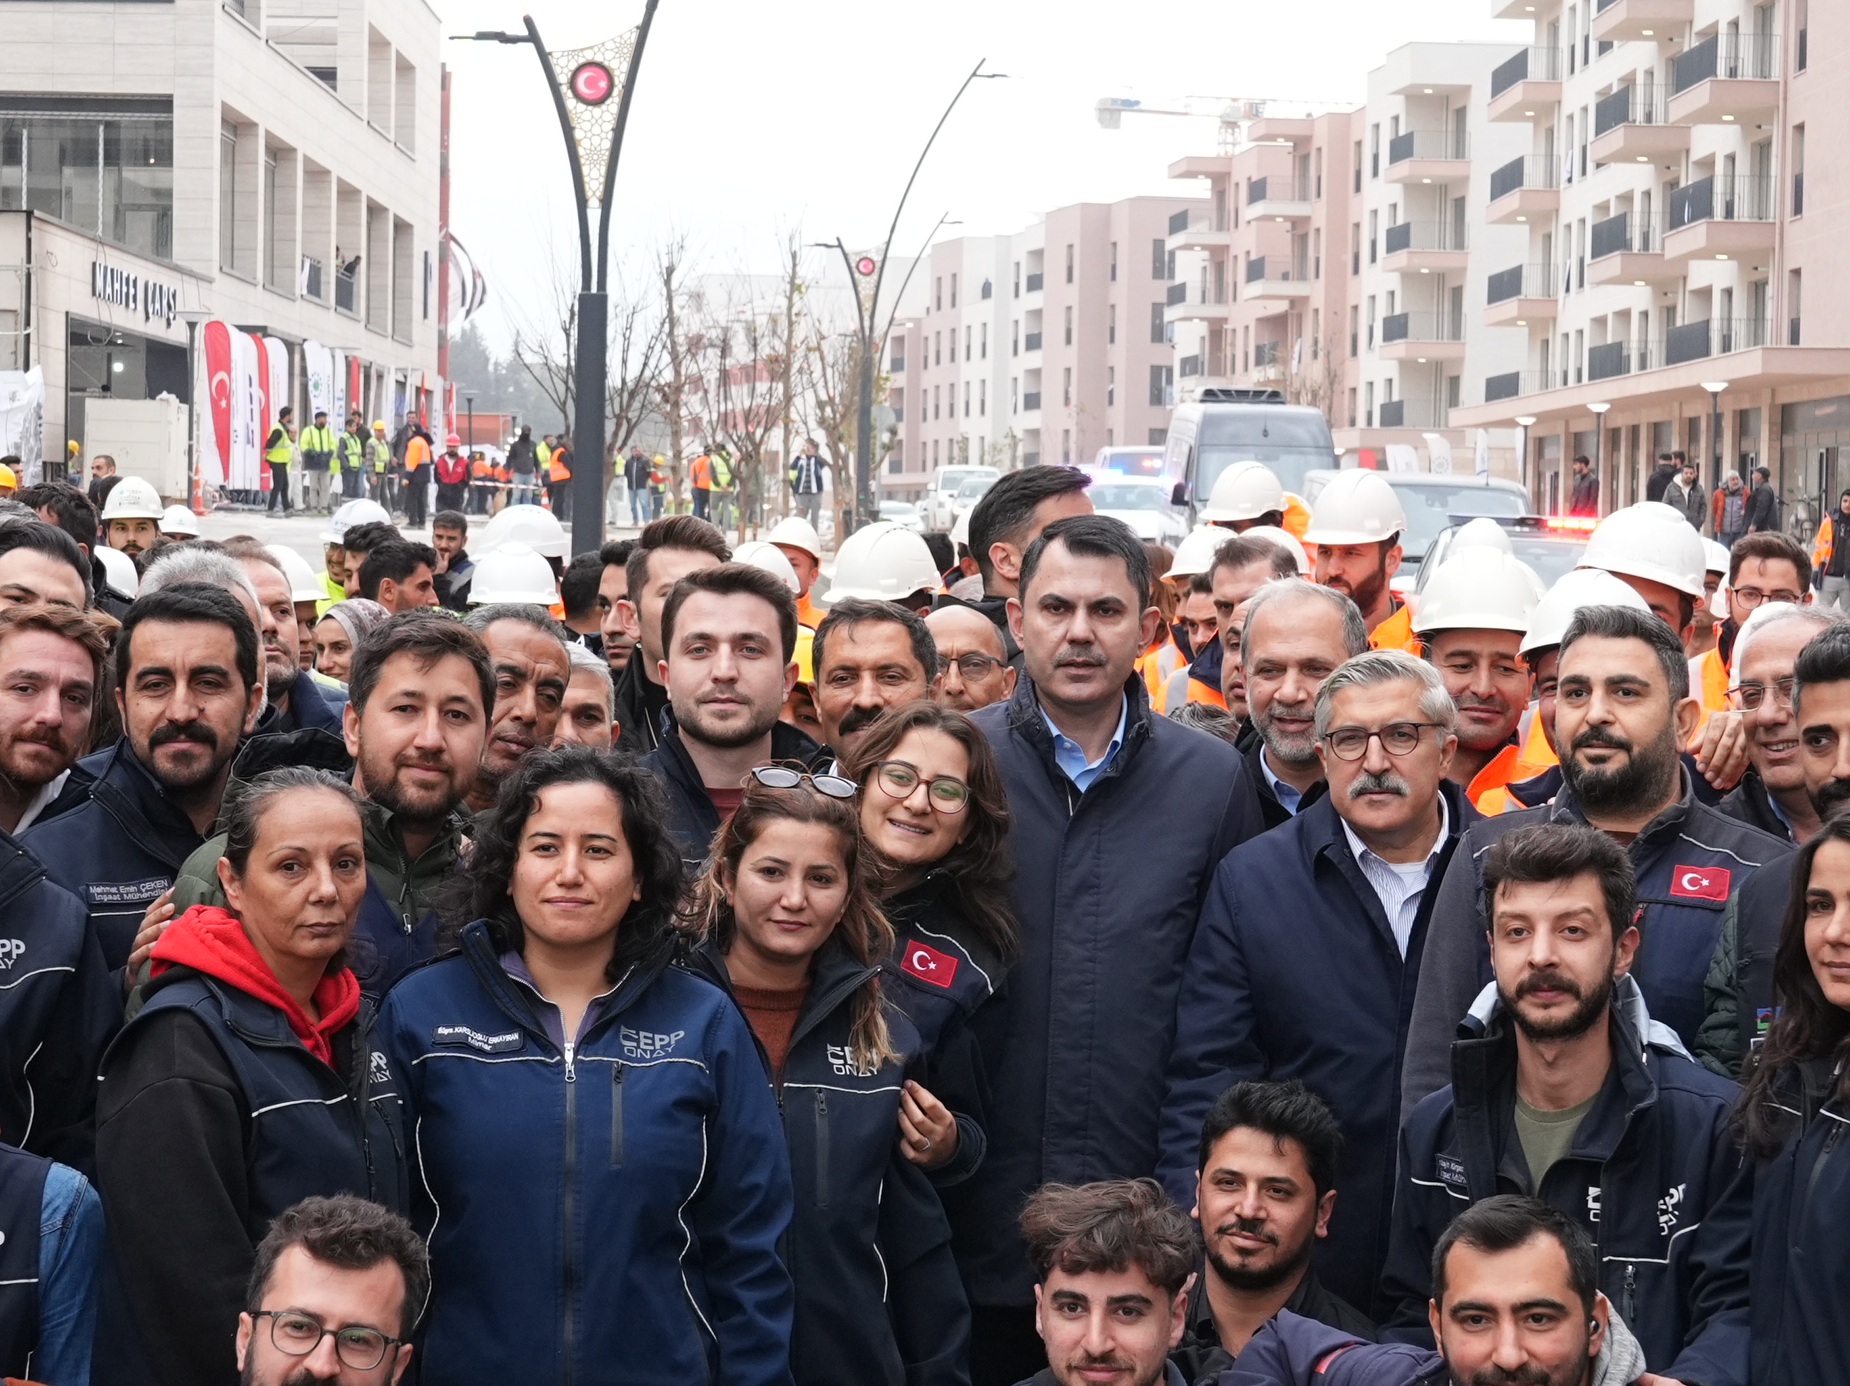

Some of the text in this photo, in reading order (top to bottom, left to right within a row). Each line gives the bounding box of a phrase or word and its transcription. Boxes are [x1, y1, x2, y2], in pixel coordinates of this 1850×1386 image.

[89, 879, 168, 895] Mehmet Emin ÇEKEN
[639, 1030, 685, 1051] EPP
[624, 1044, 675, 1059] ONAY
[369, 1069, 392, 1084] NAY
